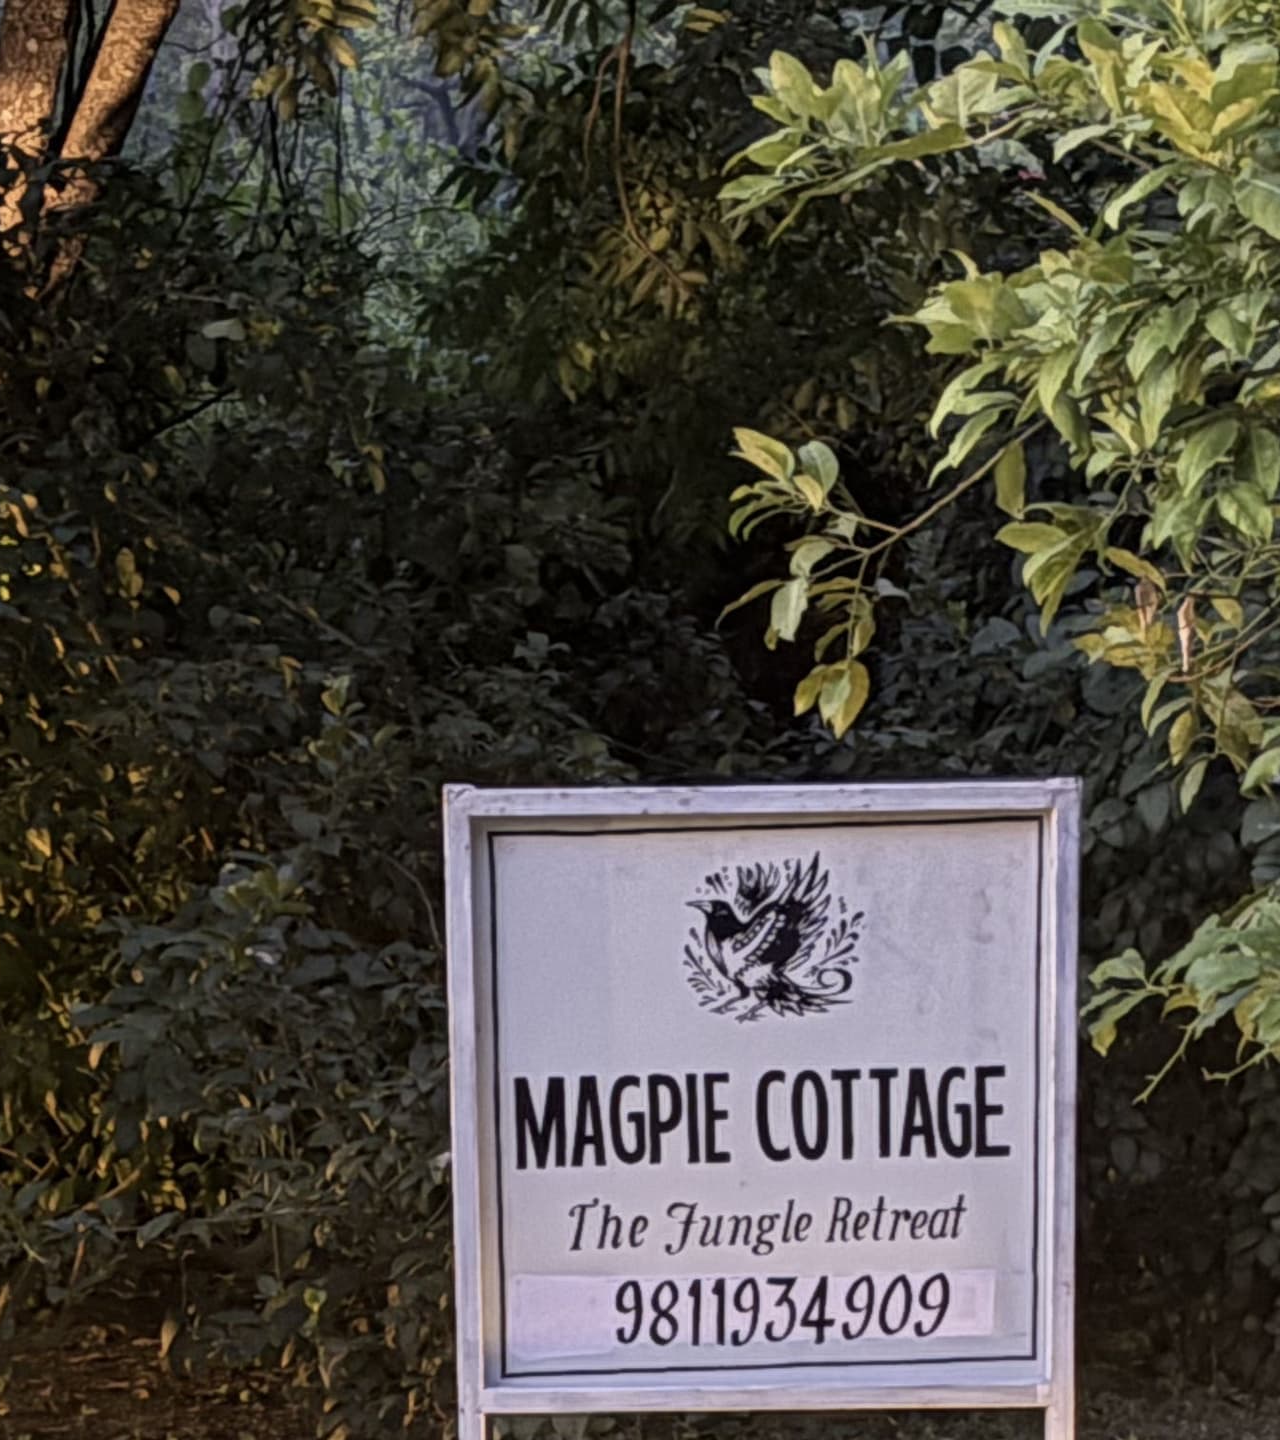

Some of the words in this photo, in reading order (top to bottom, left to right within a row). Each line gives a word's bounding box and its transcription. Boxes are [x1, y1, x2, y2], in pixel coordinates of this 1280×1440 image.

[514, 1072, 730, 1170] MAGPIE
[756, 1065, 1011, 1163] COTTAGE
[569, 1198, 648, 1251] The
[664, 1199, 812, 1255] Jungle
[828, 1194, 967, 1244] Retreat
[615, 1272, 951, 1347] 9811934909
